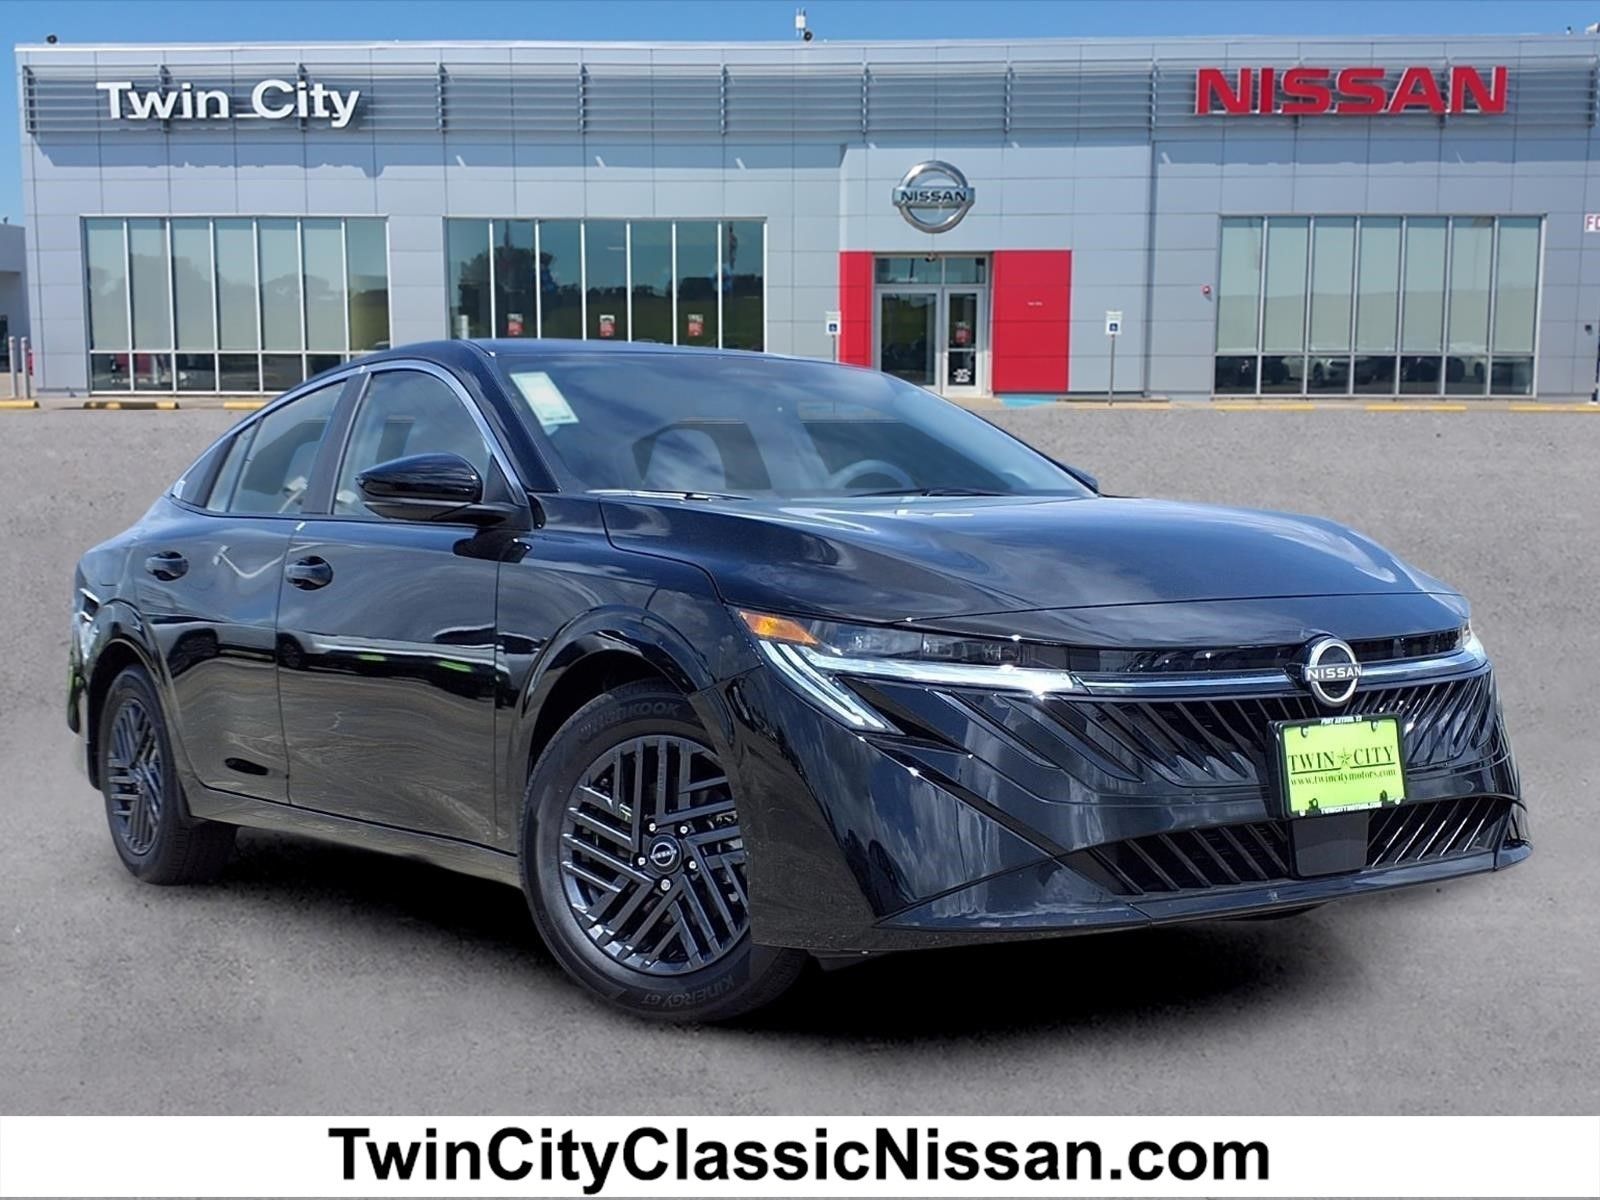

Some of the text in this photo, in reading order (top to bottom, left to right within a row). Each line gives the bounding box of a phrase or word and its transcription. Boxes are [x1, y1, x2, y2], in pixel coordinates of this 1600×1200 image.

[1194, 65, 1508, 115] NISSAN
[96, 79, 360, 128] Twin City
[900, 190, 967, 202] NISSAN
[1307, 665, 1362, 680] NISSAN
[1288, 745, 1393, 771] TWIN CITY
[1291, 769, 1396, 785] www.twincitymotors.com
